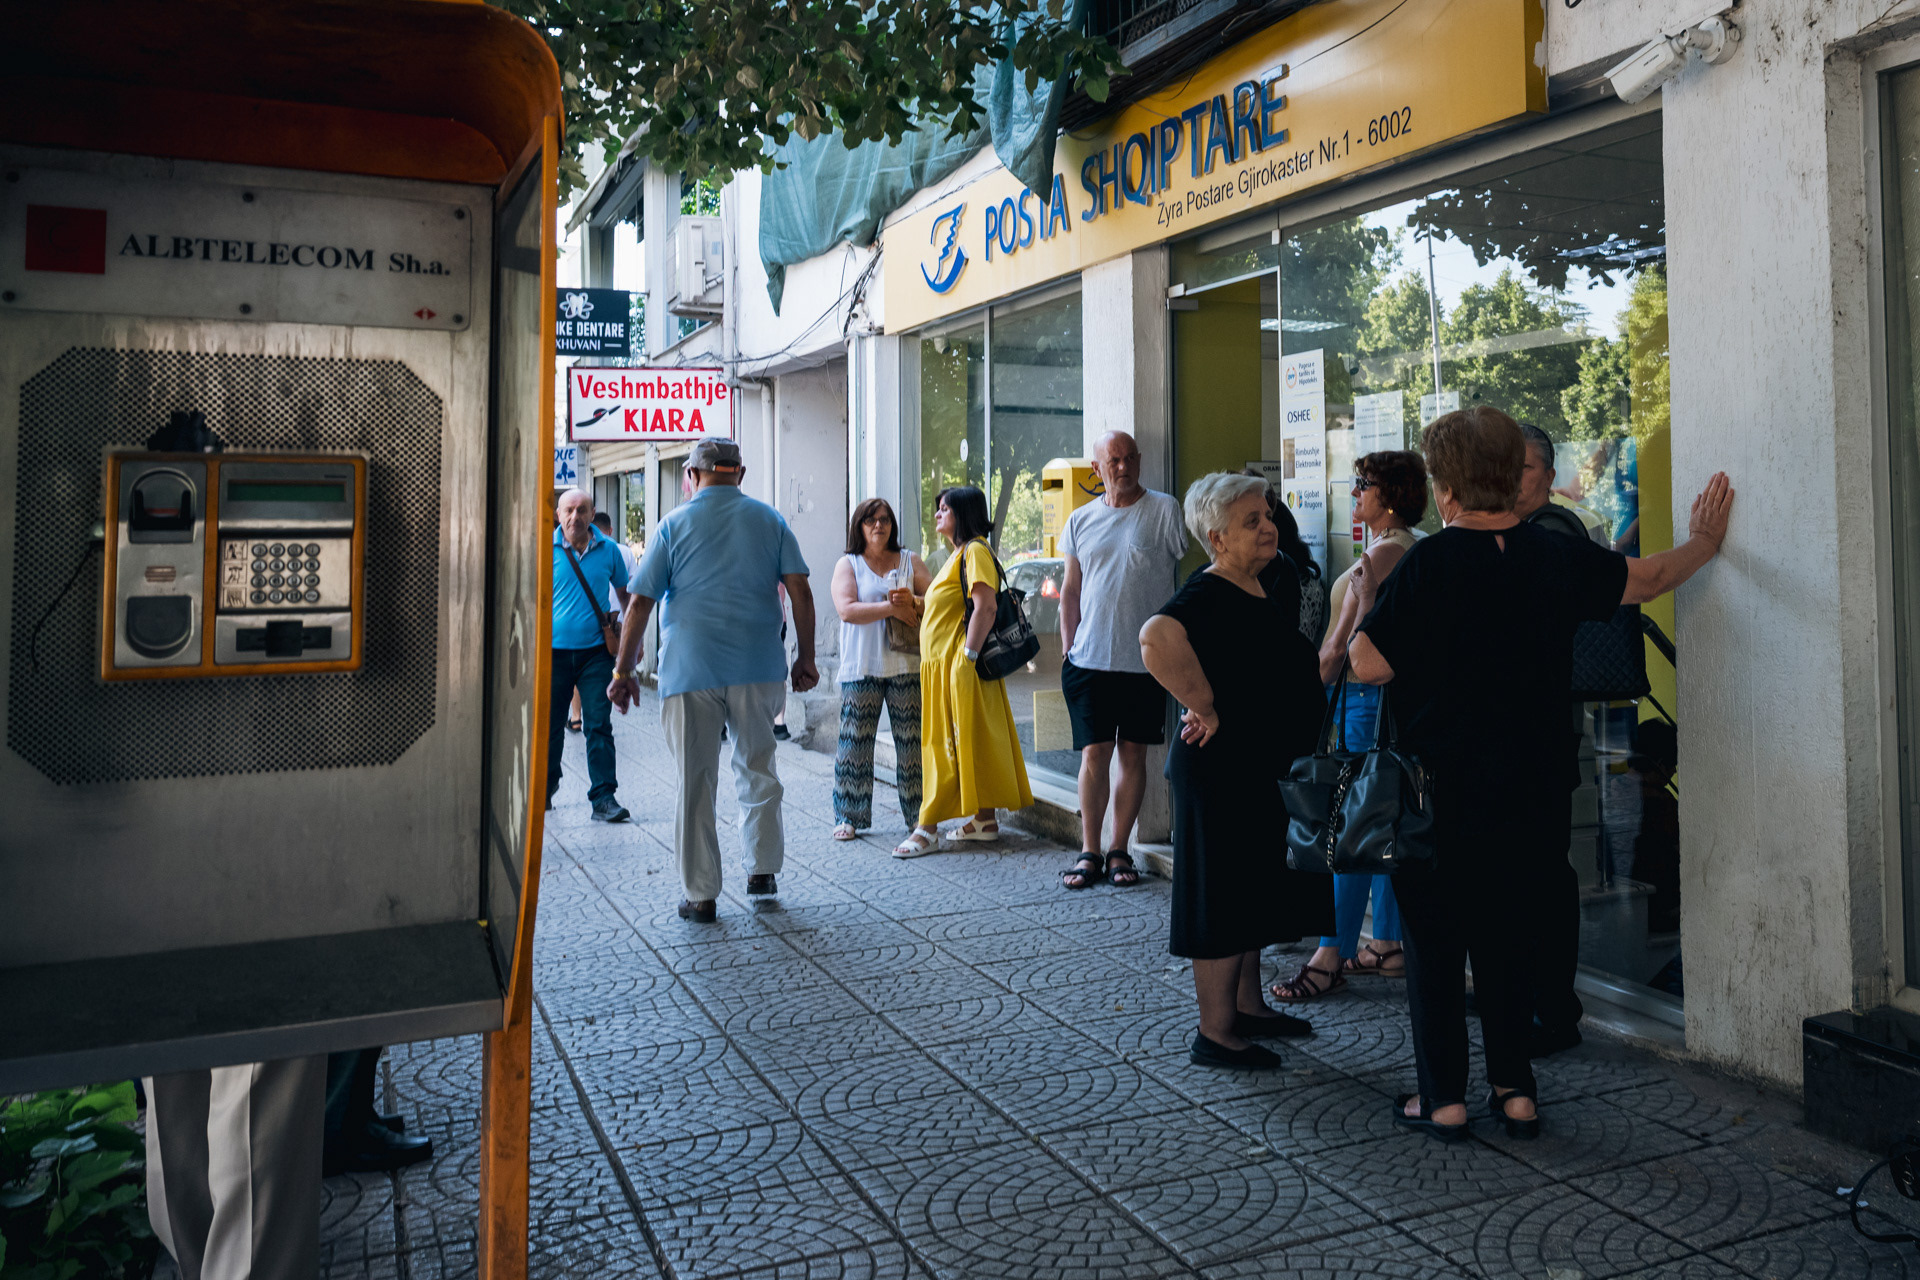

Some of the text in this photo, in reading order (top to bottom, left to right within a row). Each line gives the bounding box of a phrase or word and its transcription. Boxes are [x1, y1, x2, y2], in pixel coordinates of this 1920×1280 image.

[1081, 63, 1290, 222] SHQIPTARE
[1158, 202, 1183, 228] Zyra
[1186, 180, 1234, 214] Postare
[1238, 149, 1314, 198] Gjirokaster
[1368, 106, 1412, 147] 6002
[119, 233, 451, 276] ALBTELECOM Sh.a.
[577, 321, 624, 338] DENTARE
[577, 375, 727, 406] Veshmbathje
[624, 408, 705, 432] KIARA
[1287, 409, 1311, 423] OSHEE
[1295, 459, 1322, 469] Elektronike
[1304, 490, 1320, 500] Gjobat
